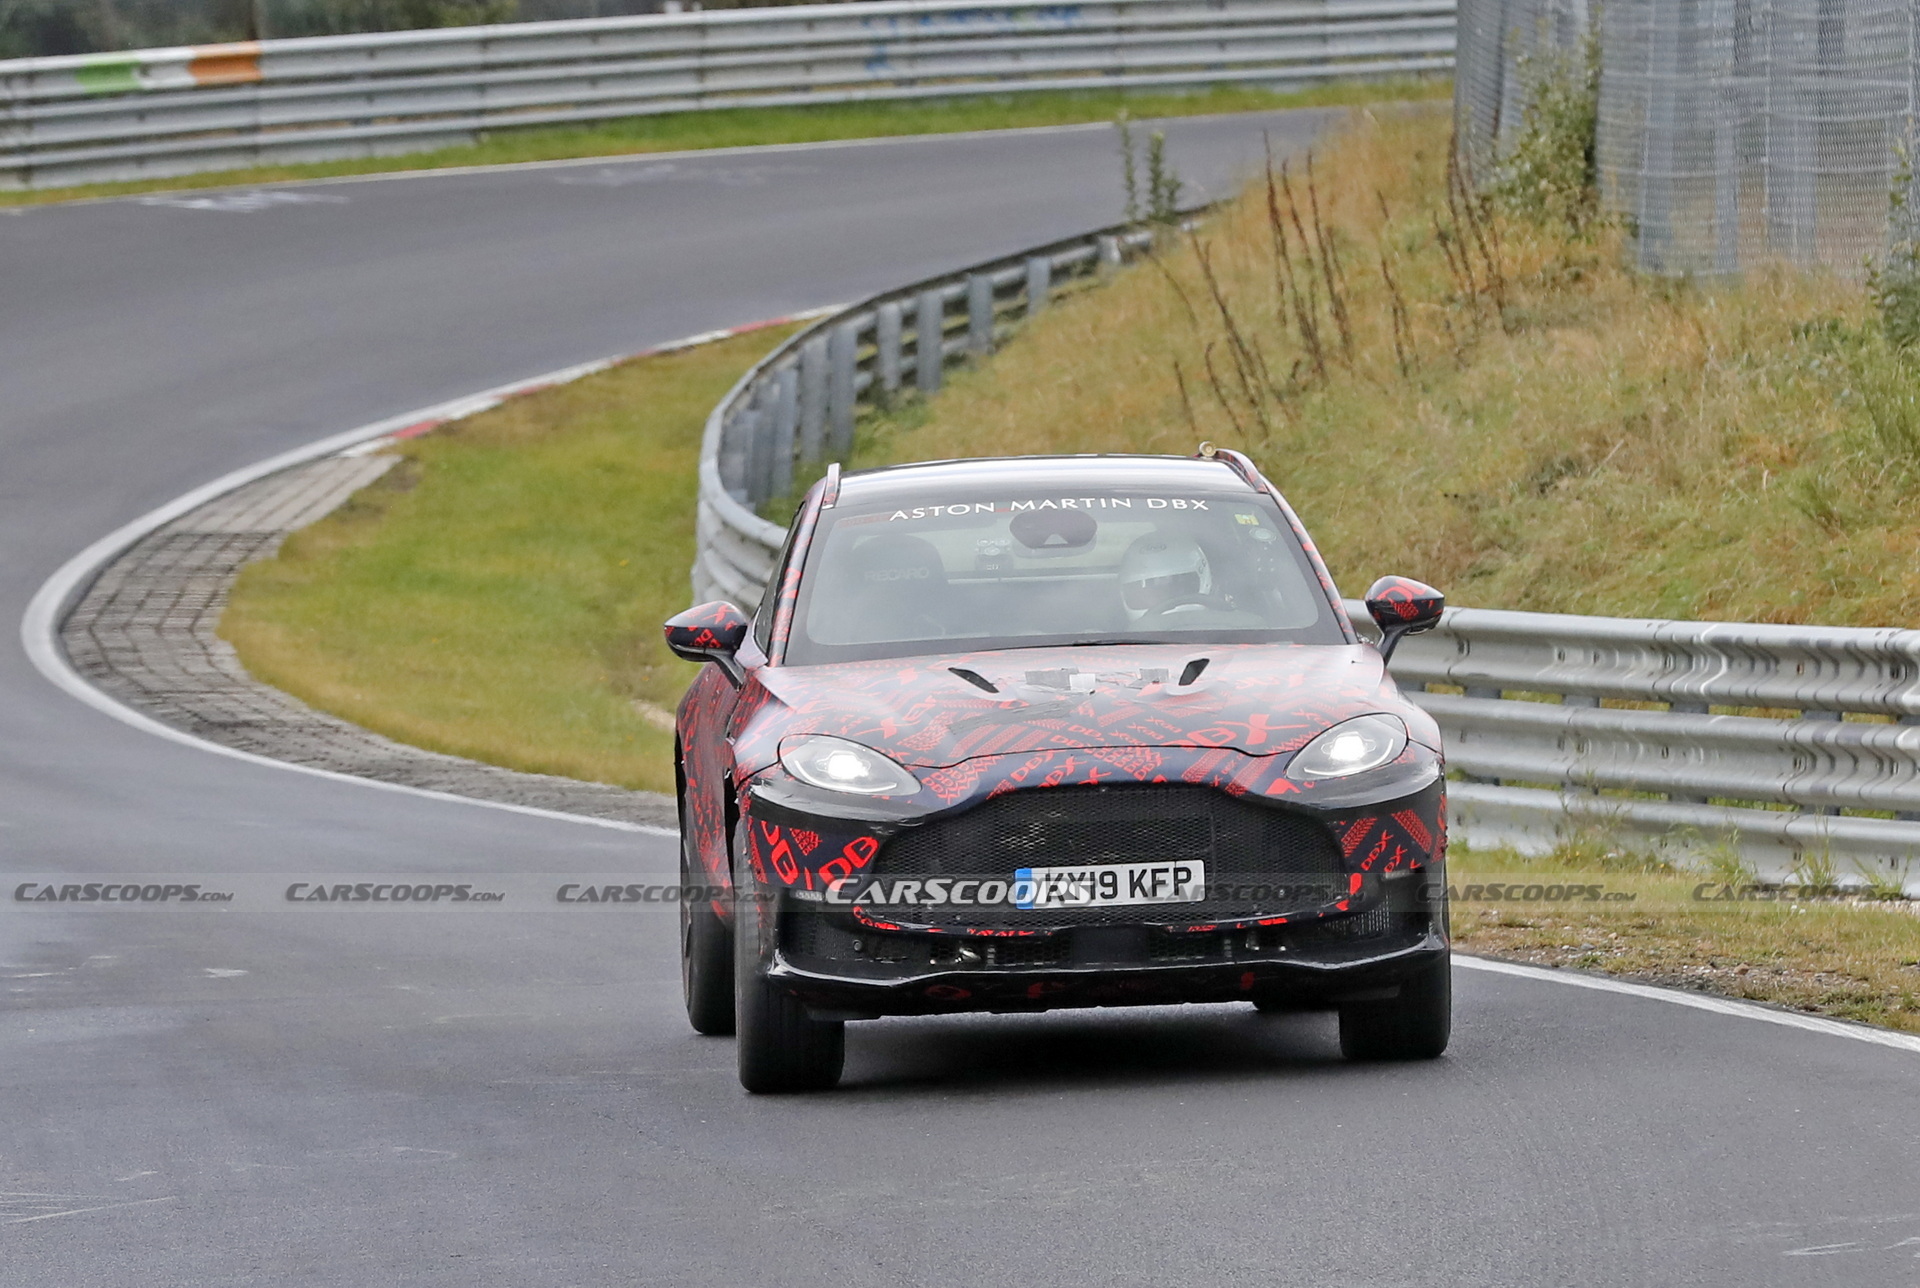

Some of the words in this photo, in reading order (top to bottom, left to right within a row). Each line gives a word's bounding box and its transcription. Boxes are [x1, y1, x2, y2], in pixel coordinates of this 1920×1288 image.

[889, 502, 994, 521] ASTON
[1010, 498, 1131, 511] MARTIN
[1146, 498, 1209, 511] DBX
[1045, 871, 1118, 902] KY19
[1129, 866, 1192, 899] KFP
